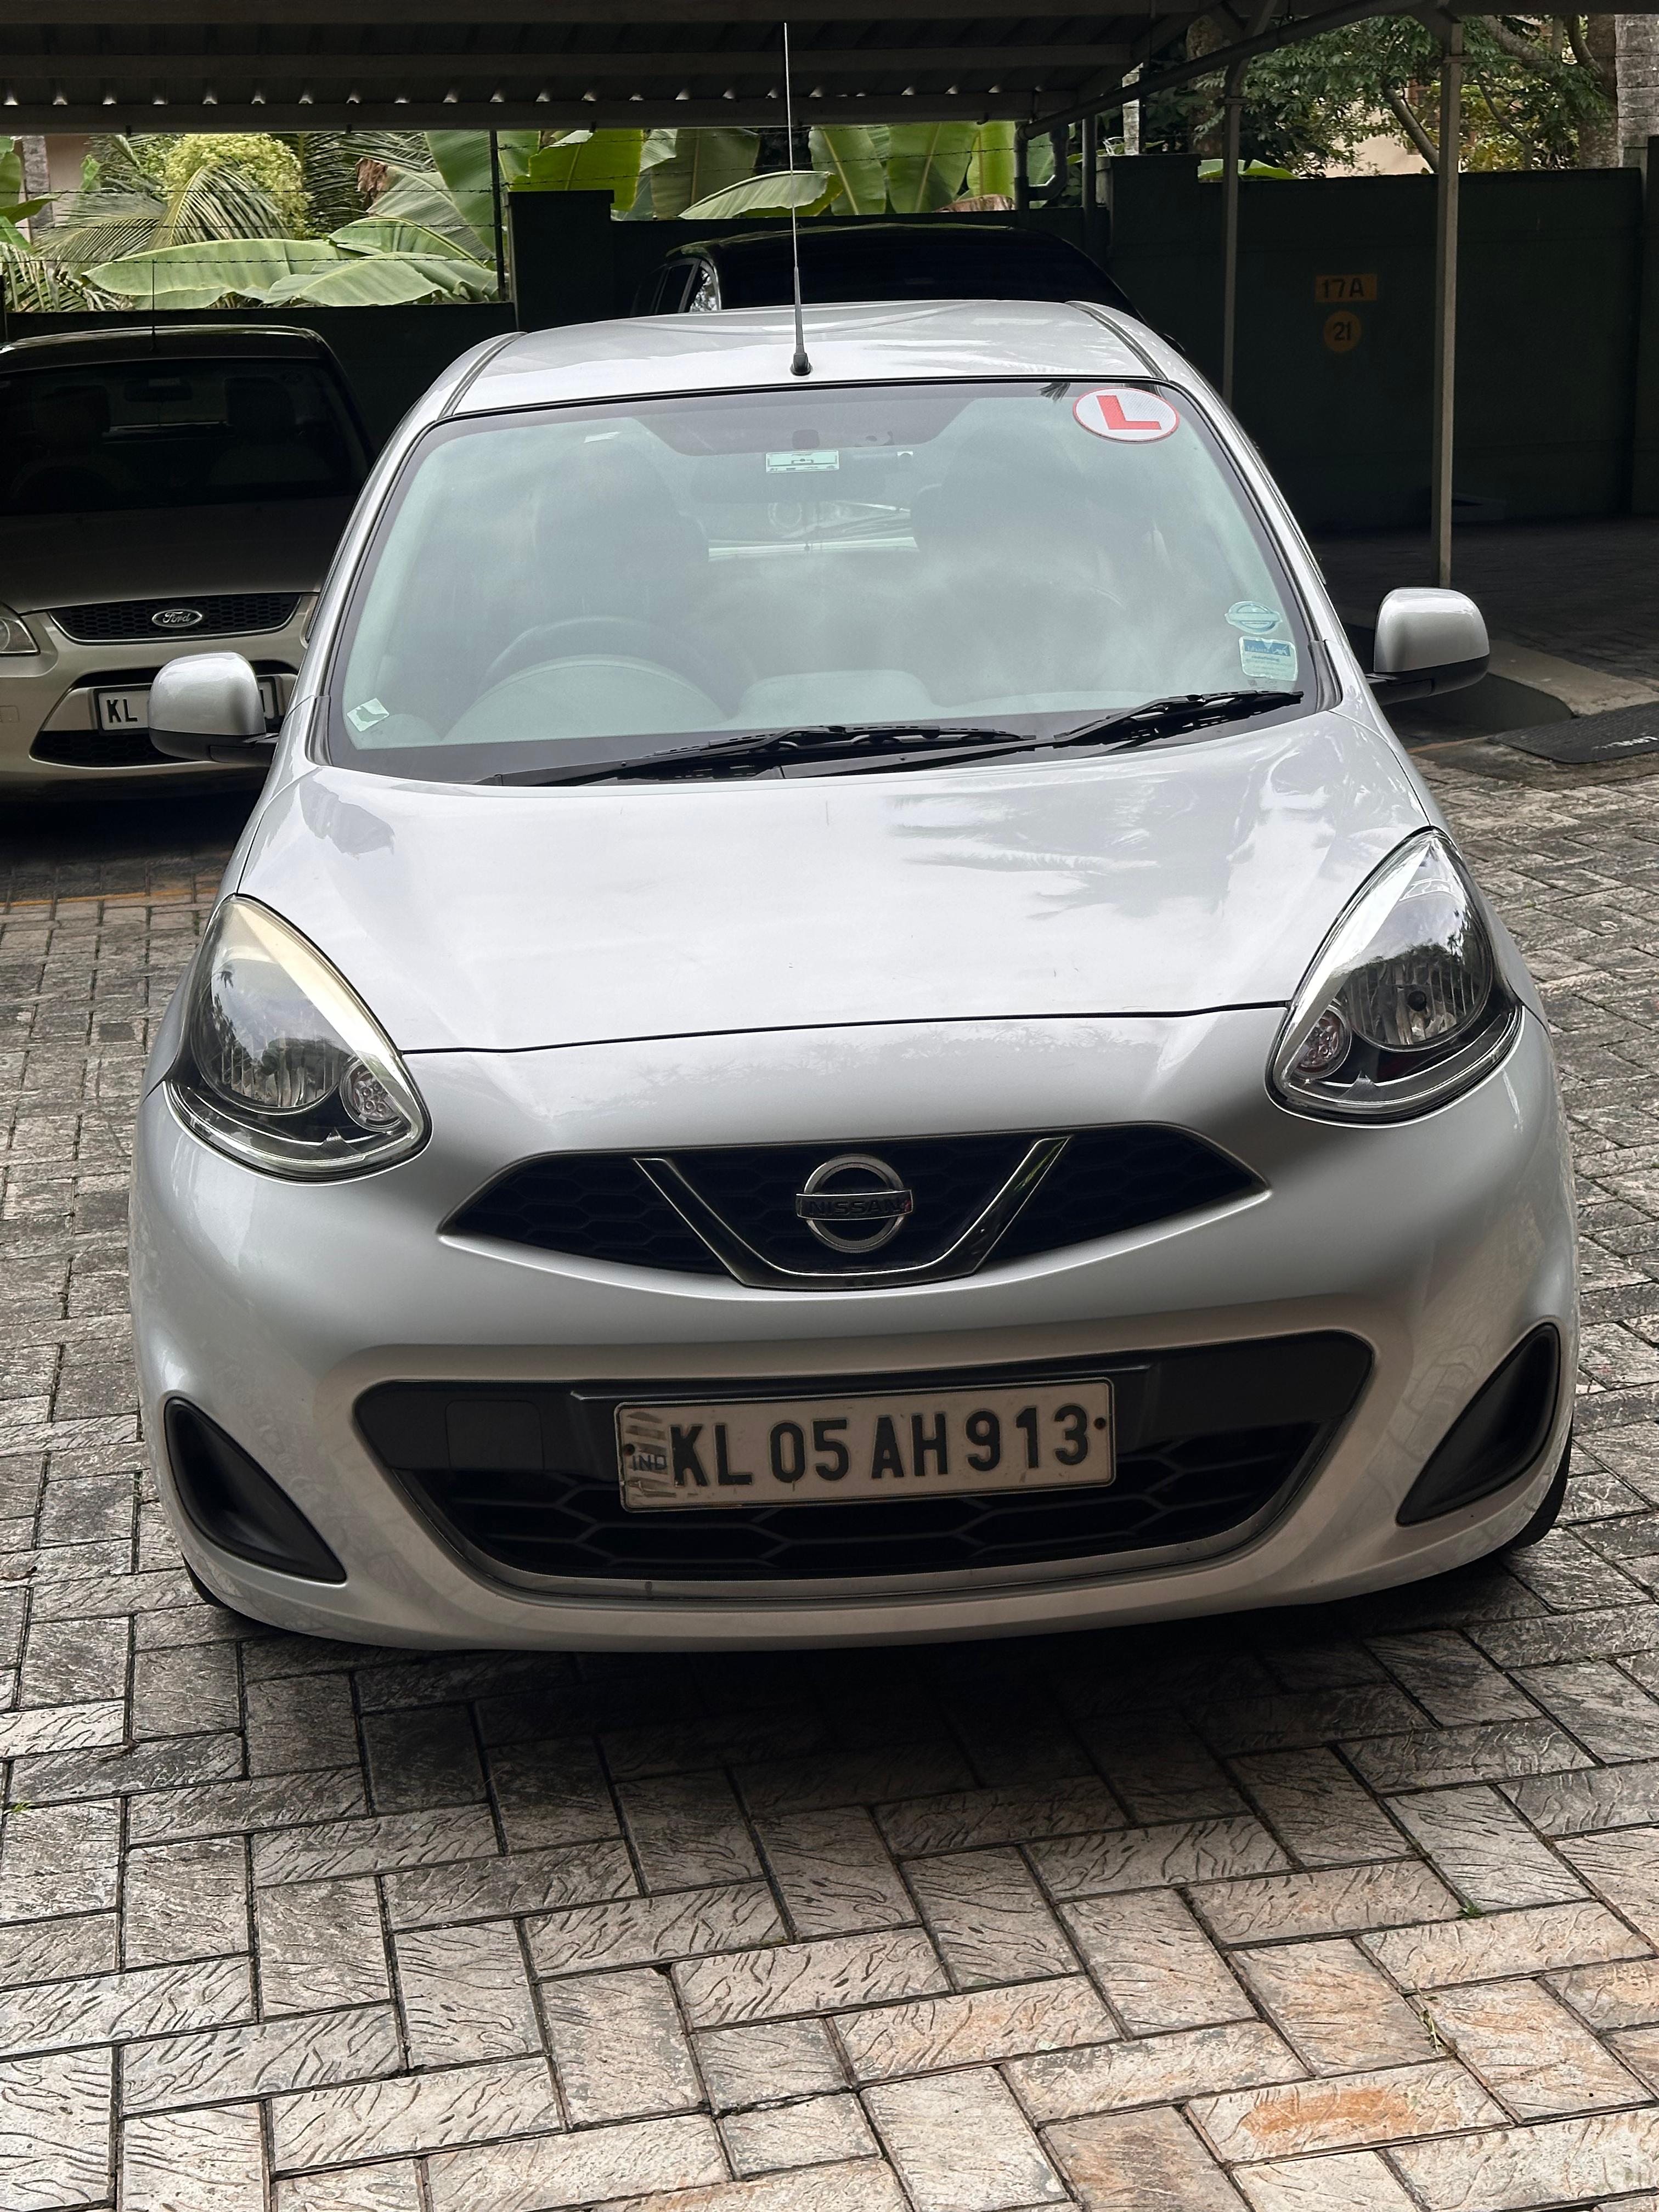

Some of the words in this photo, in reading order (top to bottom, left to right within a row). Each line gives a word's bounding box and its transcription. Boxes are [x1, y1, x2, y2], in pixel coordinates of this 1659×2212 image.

[1322, 277, 1364, 298] 17A
[1333, 320, 1352, 341] 21
[1096, 394, 1162, 430] L
[162, 611, 191, 624] Ford
[106, 698, 138, 724] KL
[809, 1197, 903, 1216] NISSAN
[669, 1423, 753, 1487] KL
[769, 1418, 850, 1483] 05
[871, 1412, 948, 1480] AH
[964, 1403, 1090, 1471] 913
[632, 1454, 668, 1472] IND
